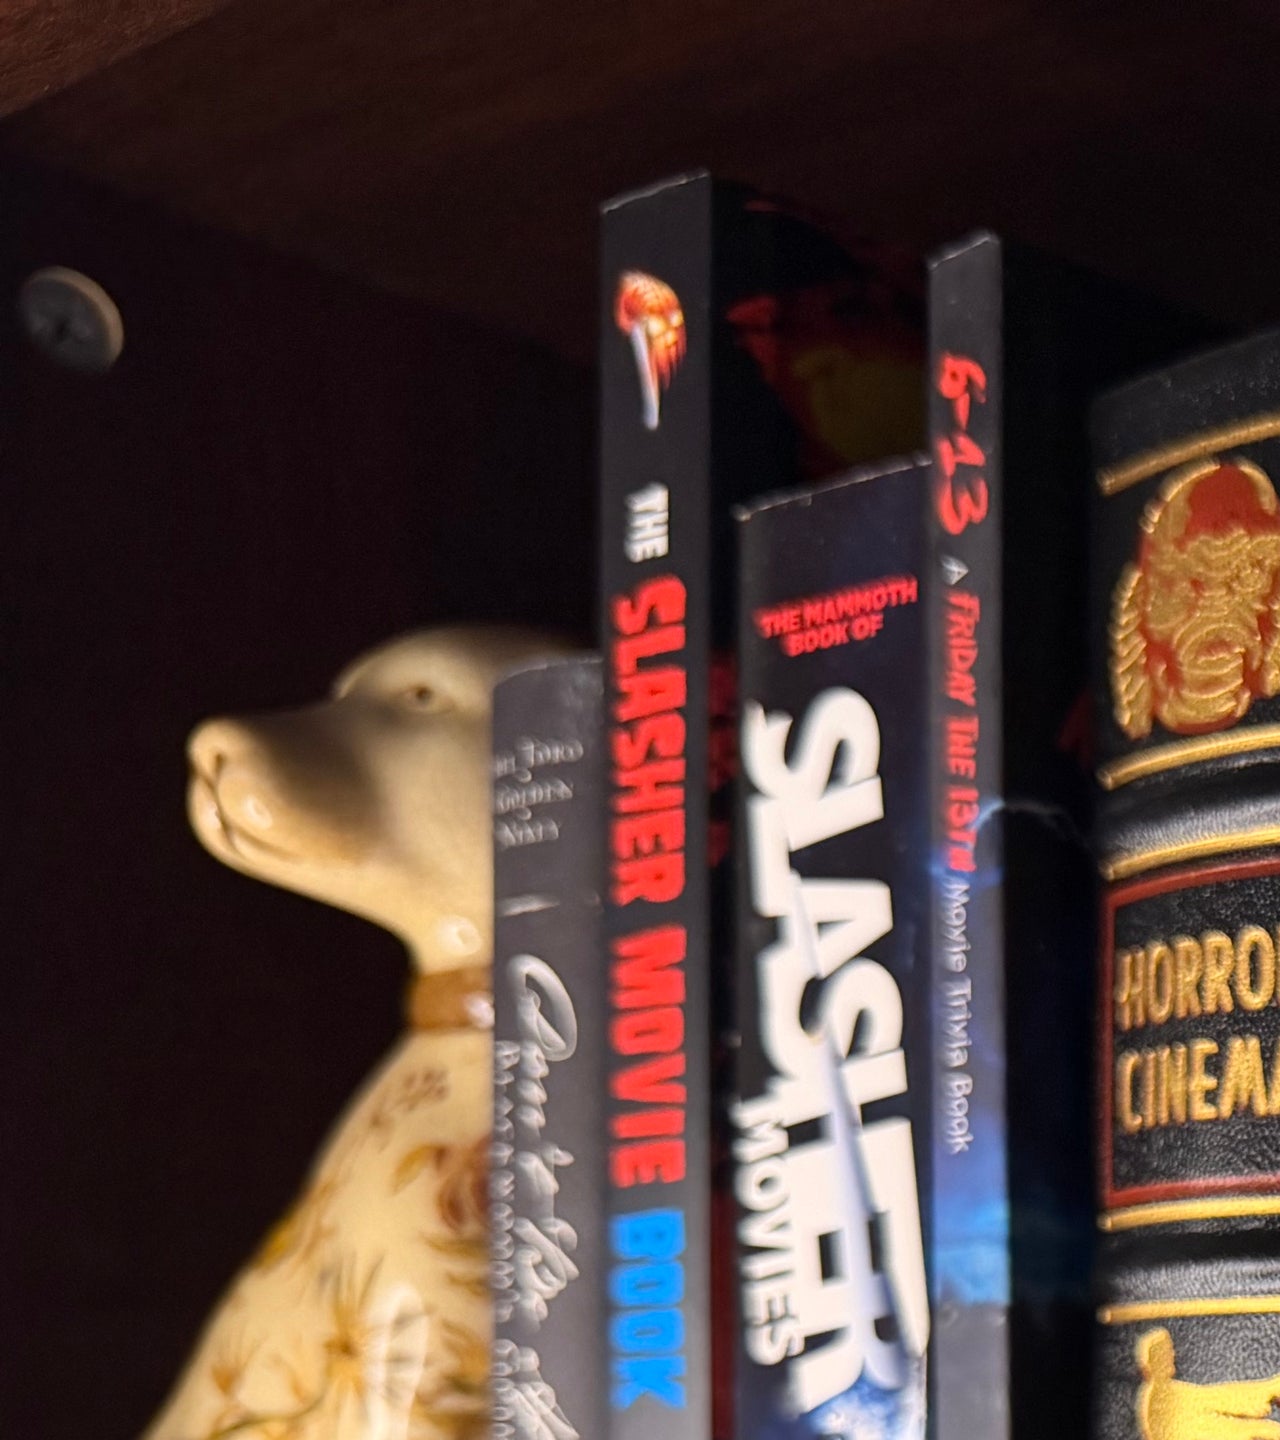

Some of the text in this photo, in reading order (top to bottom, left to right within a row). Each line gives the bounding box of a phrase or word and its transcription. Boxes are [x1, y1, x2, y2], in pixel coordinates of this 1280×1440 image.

[936, 353, 988, 535] 6-13
[759, 577, 918, 639] THE MAMMOTH
[786, 613, 885, 657] BOOK OF
[943, 591, 980, 704] FRIDAY
[945, 715, 978, 777] THE
[609, 482, 687, 1410] THE SLASHER MOVIE BOOK
[940, 876, 972, 975] Movie
[742, 687, 931, 1416] SLASHER
[942, 978, 972, 1066] Trivia
[942, 1072, 973, 1155] Book
[732, 1102, 806, 1367] MOVIES
